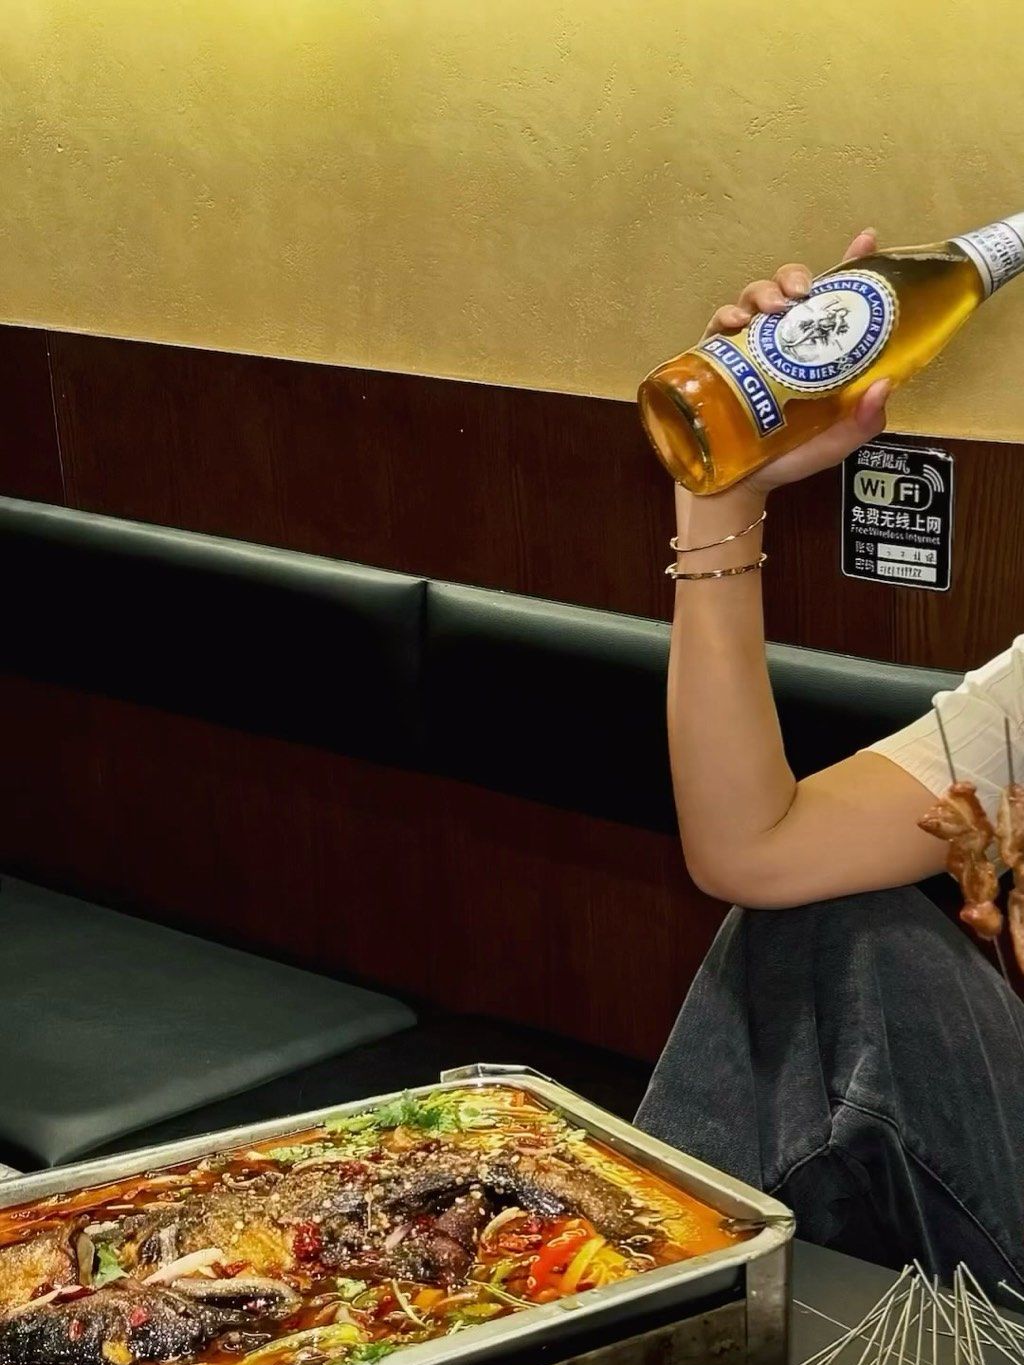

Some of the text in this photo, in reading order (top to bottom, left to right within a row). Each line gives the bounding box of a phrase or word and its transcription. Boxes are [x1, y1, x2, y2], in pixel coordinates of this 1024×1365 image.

[762, 312, 837, 380] LSENER LAGER BIER
[813, 281, 884, 361] ILSENER LAGER BIER
[703, 340, 776, 429] BLUE GIRL
[851, 506, 942, 534] 免费无线上网
